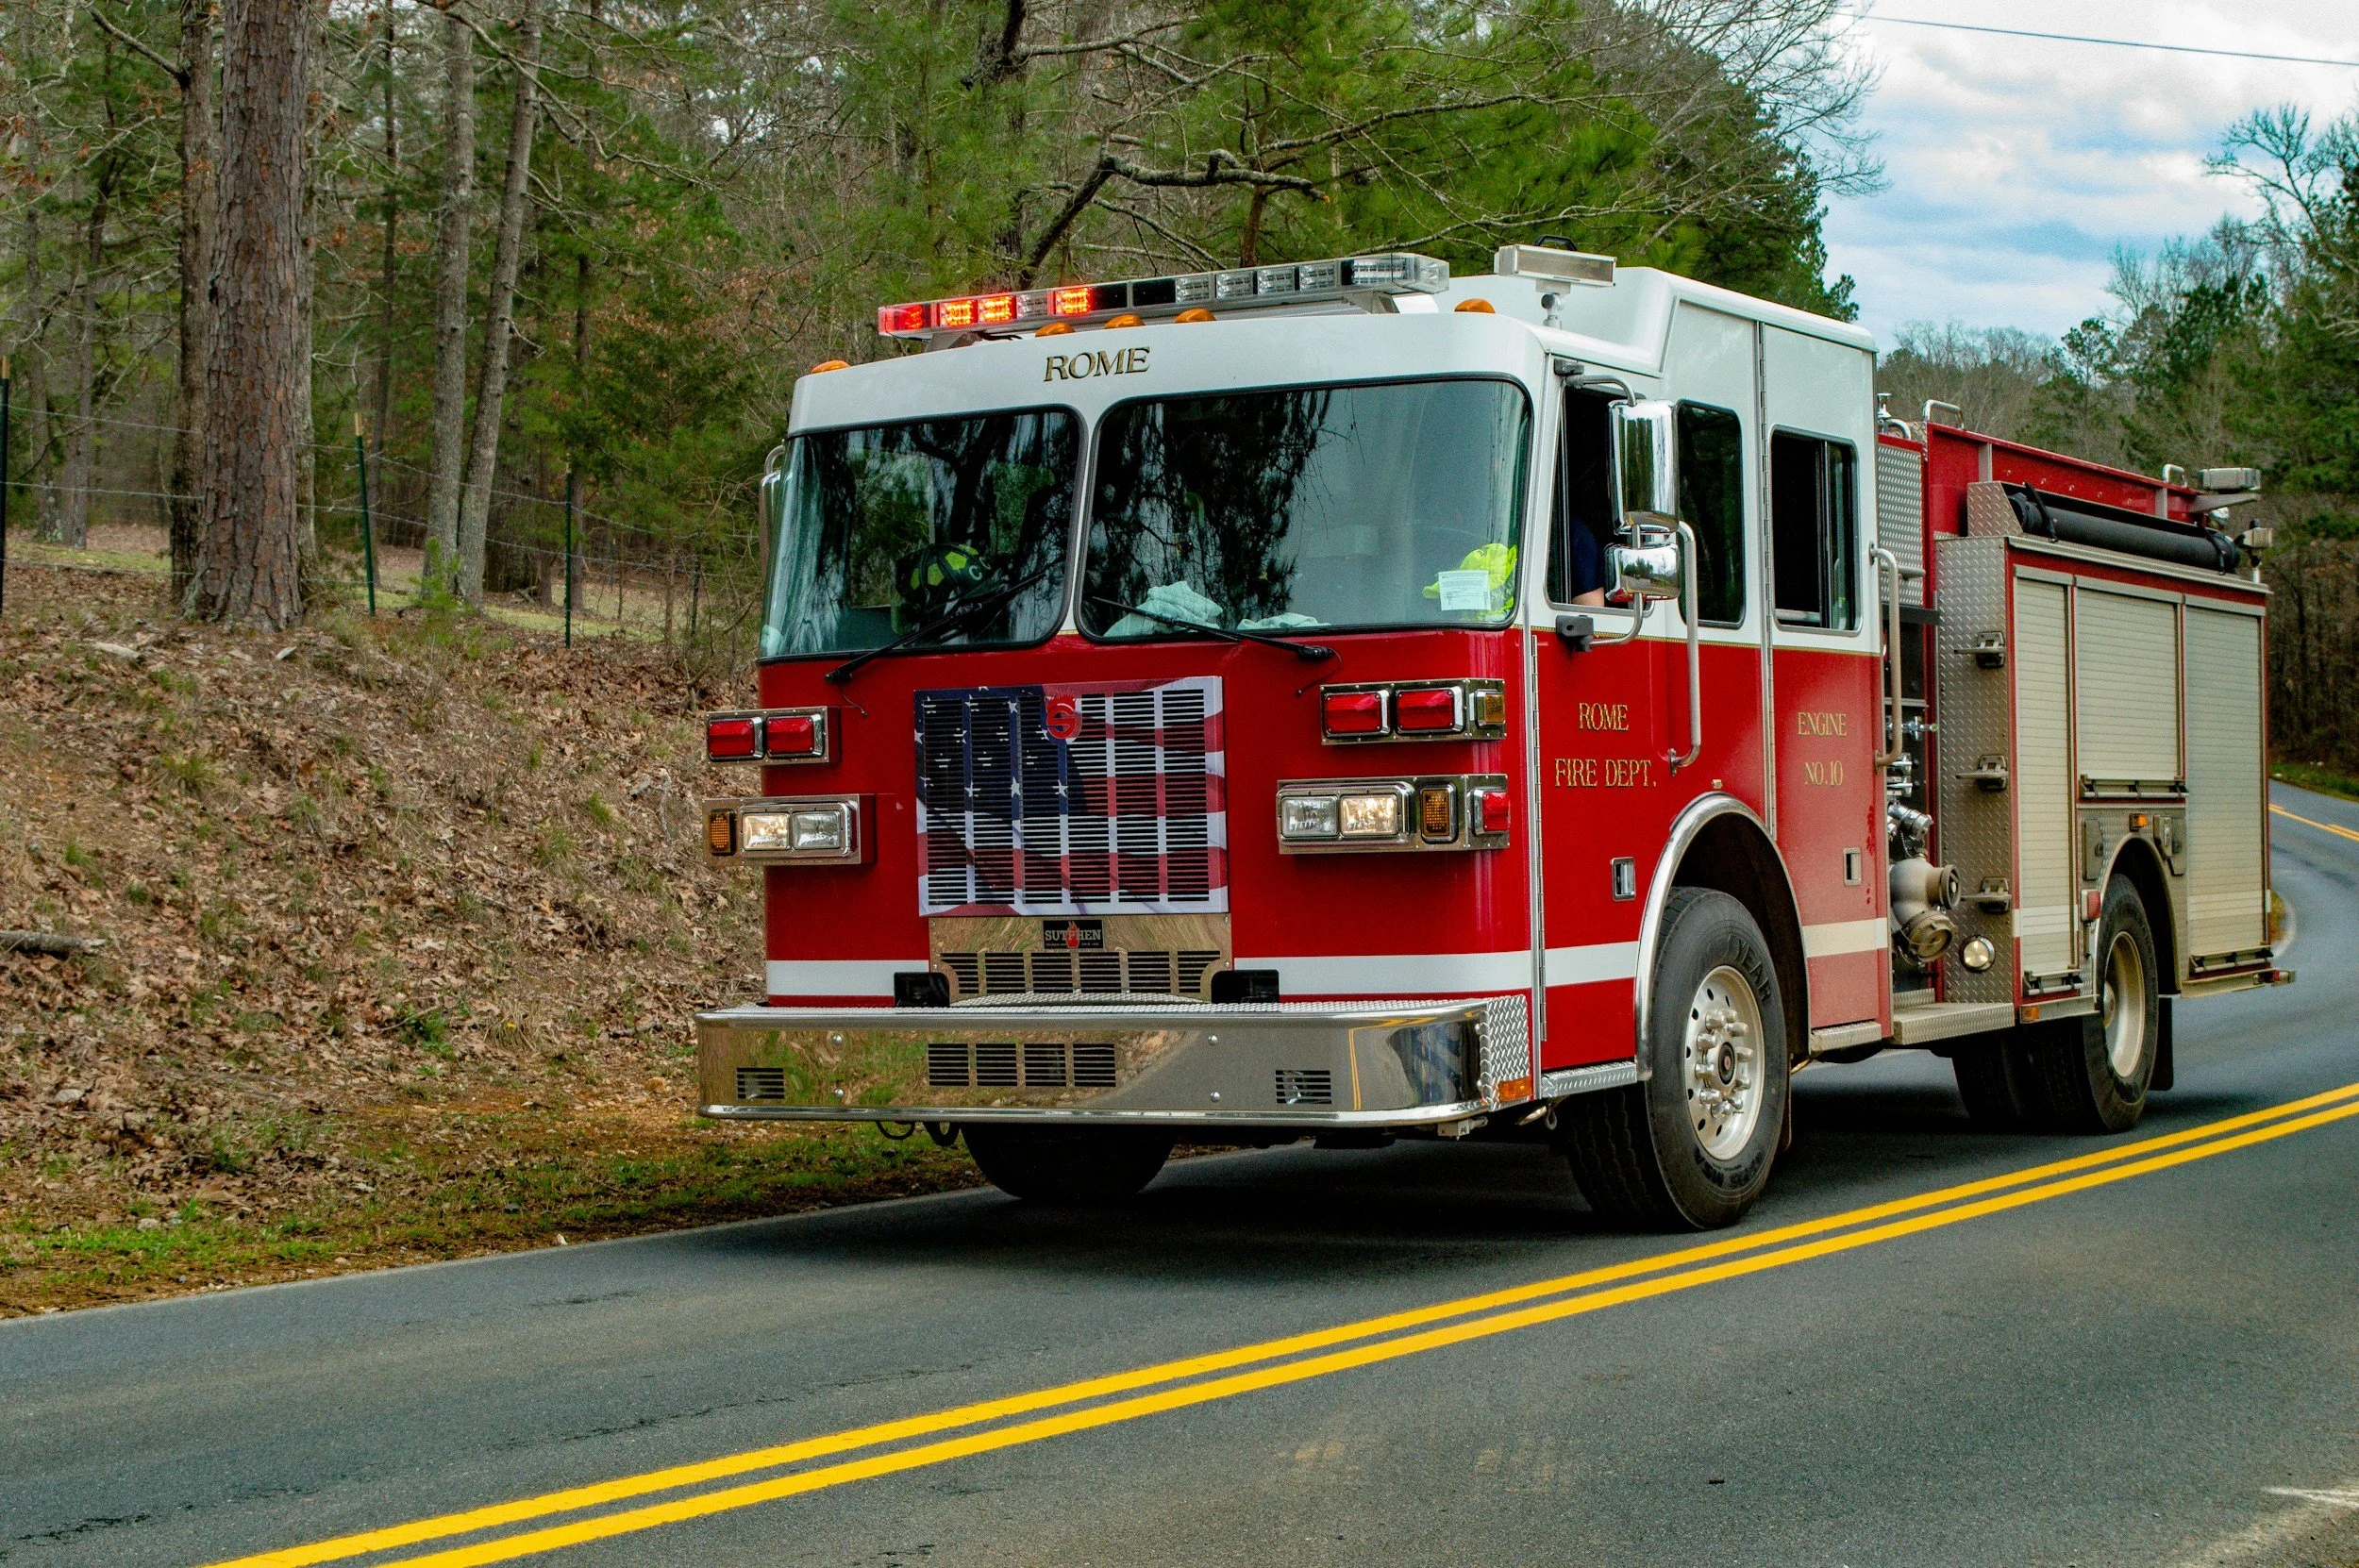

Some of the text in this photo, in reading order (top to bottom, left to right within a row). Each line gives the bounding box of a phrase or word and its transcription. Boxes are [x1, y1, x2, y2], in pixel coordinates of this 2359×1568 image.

[1043, 346, 1150, 382] ROME
[1579, 702, 1630, 731] ROME
[1798, 711, 1848, 737] ENGINE
[1554, 758, 1657, 788] FIRE DEPT.
[1045, 928, 1103, 942] SUTPHEN
